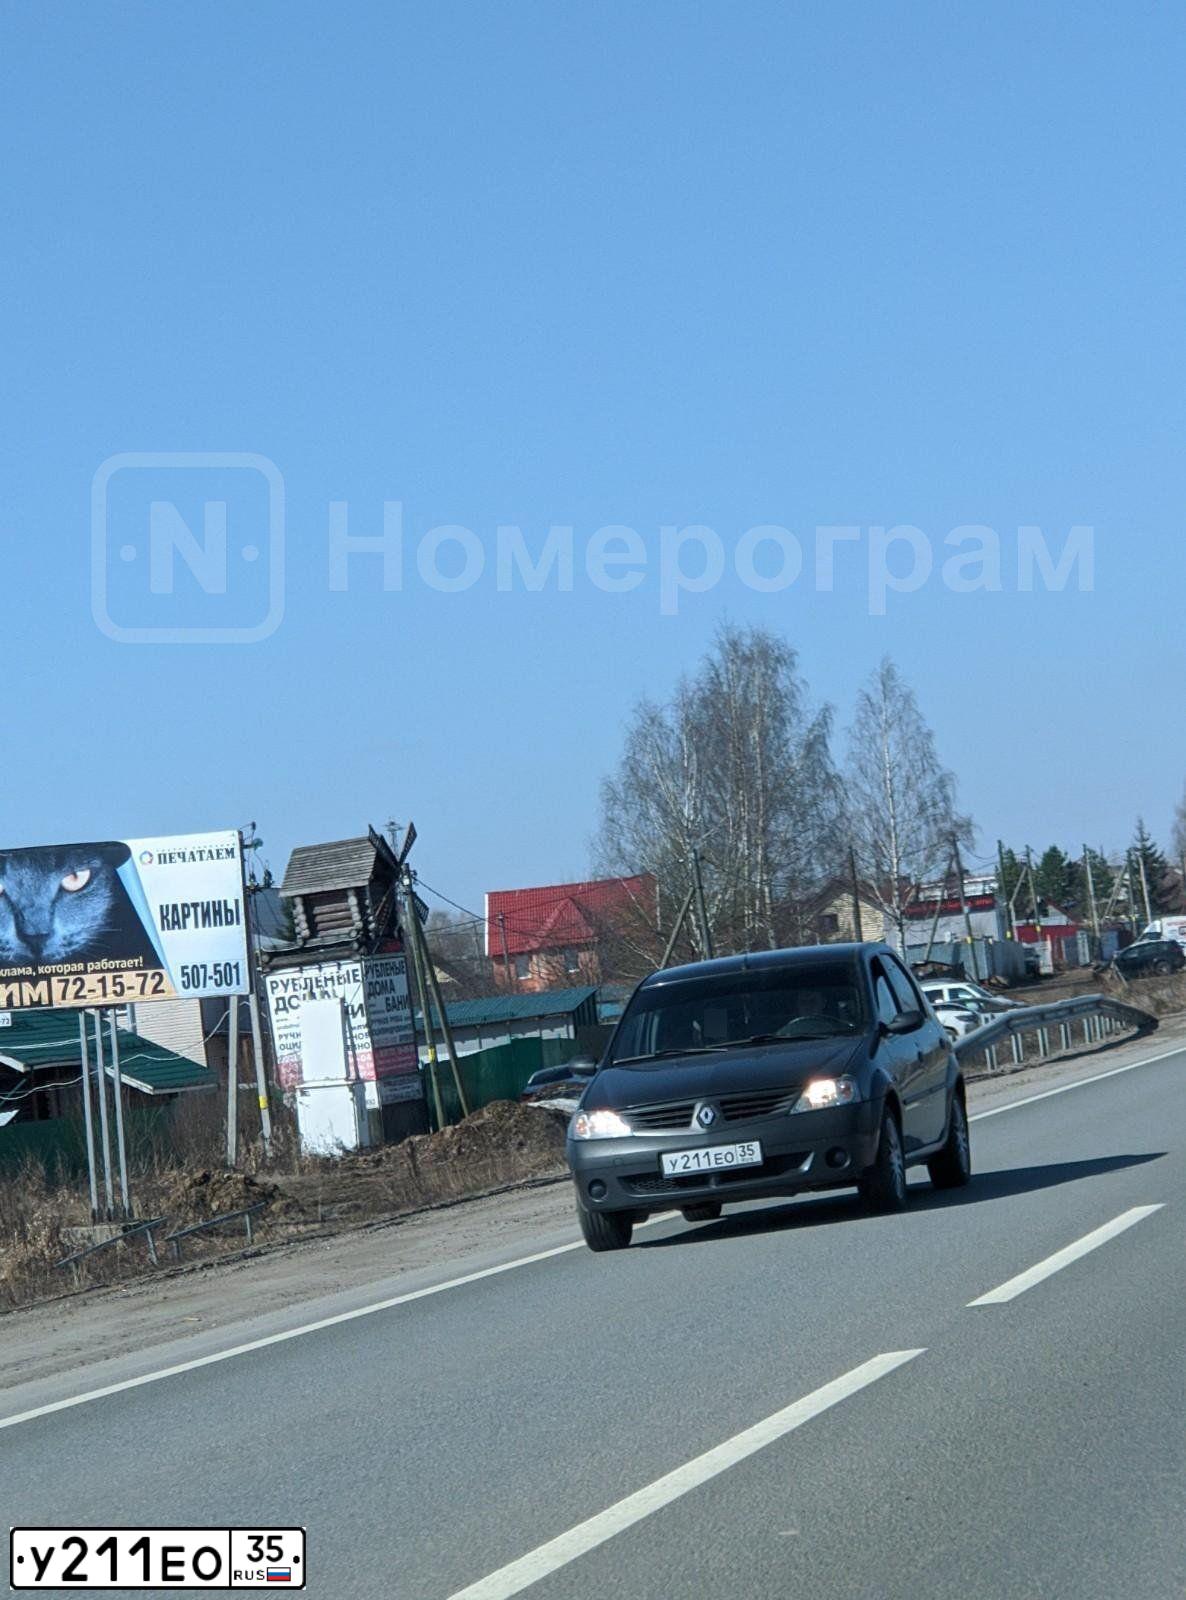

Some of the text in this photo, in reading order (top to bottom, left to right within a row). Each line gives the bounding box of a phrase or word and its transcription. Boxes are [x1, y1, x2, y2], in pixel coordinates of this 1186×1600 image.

[157, 847, 235, 865] ПЕЧАТАЕМ
[159, 899, 241, 931] КАРТИНЫ
[38, 961, 84, 975] которая
[87, 956, 143, 973] работает!
[180, 962, 241, 990] 507-501
[57, 972, 165, 1000] 72-15-72
[269, 968, 361, 995] РУБЛЕНЫЕ
[367, 979, 396, 1000] ДОМА
[669, 1144, 755, 1171] У211ЕО 35
